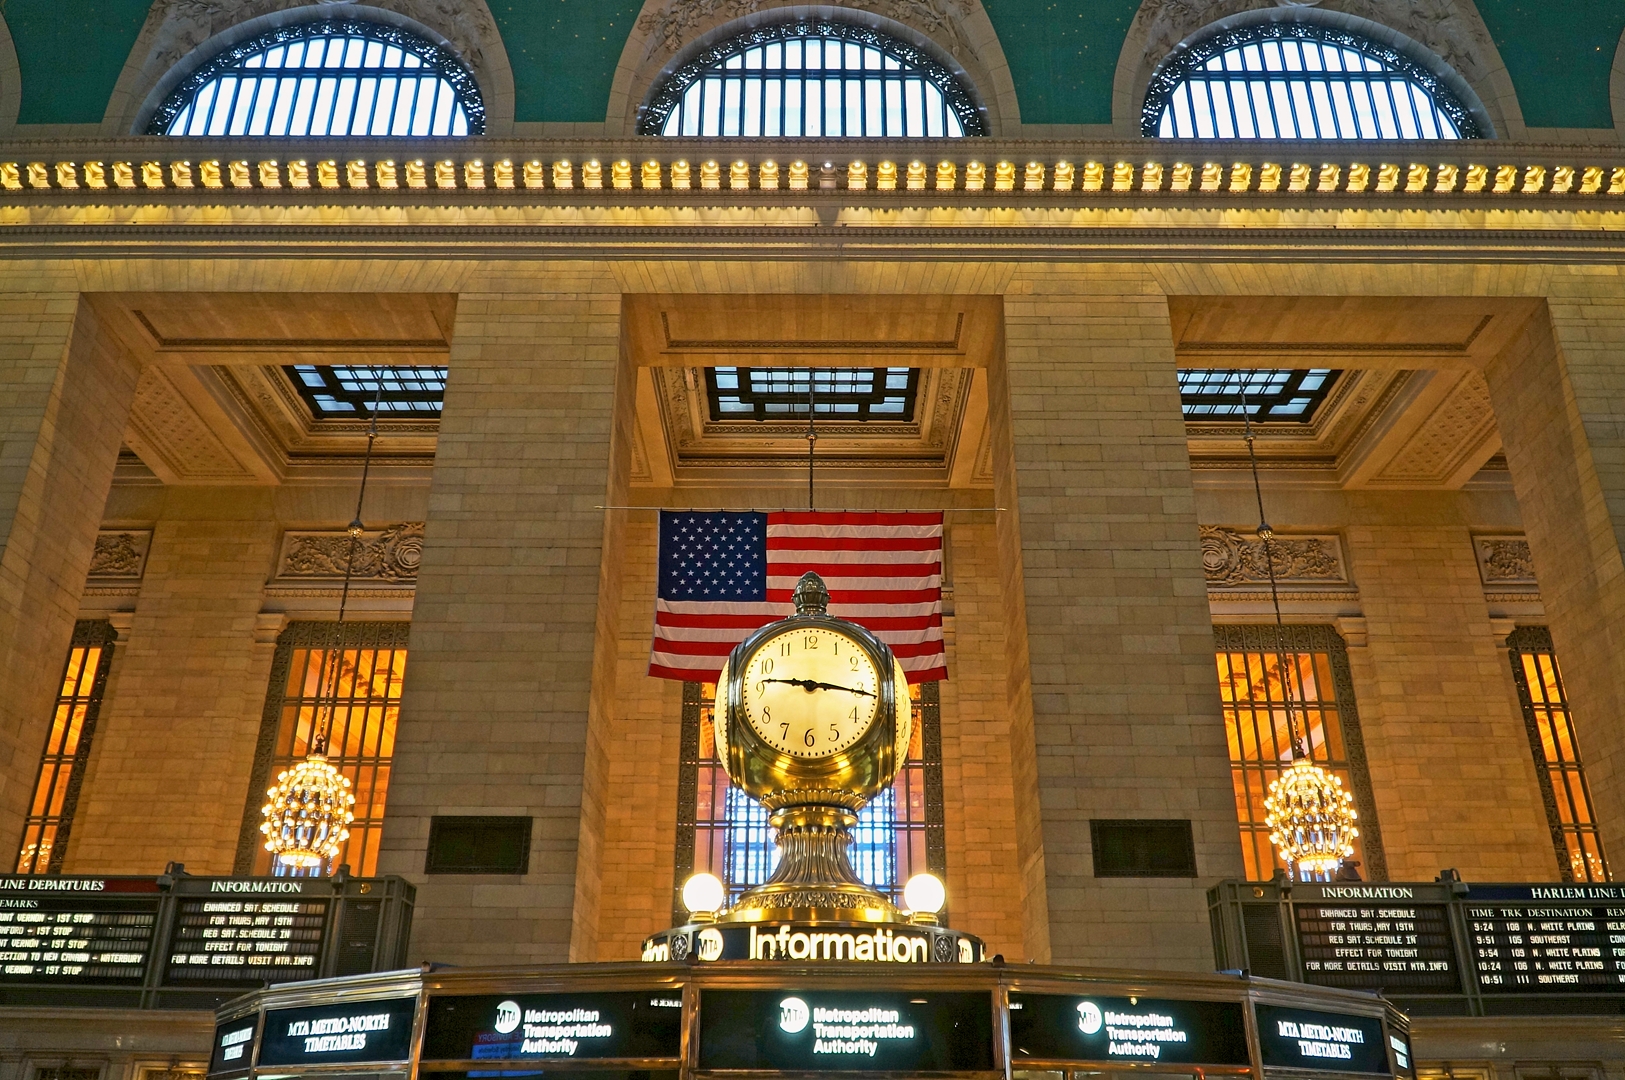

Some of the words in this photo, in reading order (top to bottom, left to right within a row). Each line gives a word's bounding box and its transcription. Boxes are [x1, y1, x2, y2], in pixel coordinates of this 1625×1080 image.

[804, 636, 818, 649] 12
[834, 642, 838, 655] 1
[780, 643, 791, 657] 11
[761, 658, 774, 674] 10
[850, 656, 859, 671] 2
[756, 680, 765, 699] 9
[854, 682, 864, 698] 3
[762, 706, 771, 724] 8
[849, 706, 859, 723] 4
[780, 723, 790, 740] 7
[805, 728, 814, 747] 6
[828, 723, 840, 742] 5
[28, 880, 105, 891] DEPARTURES
[210, 881, 302, 893] INFORMATION
[1321, 888, 1413, 899] INFORMATION
[1531, 888, 1585, 899] HARLEM
[1588, 888, 1618, 898] LINE
[204, 903, 240, 912] ENHANCED
[1320, 909, 1357, 918] ENHANCED
[1469, 909, 1494, 917] TIME
[1501, 909, 1522, 917] TRK
[1527, 908, 1592, 917] DESTINATION
[73, 913, 94, 924] STOP
[210, 916, 225, 925] FOR
[273, 917, 292, 926] 19TH
[53, 927, 73, 936] STOP
[1331, 923, 1346, 931] FOR
[1395, 923, 1414, 932] 19TH
[1474, 923, 1493, 932] 9:24
[1541, 922, 1564, 931] WHITE
[1567, 922, 1595, 931] PLAINS
[203, 929, 218, 938] REG
[279, 930, 290, 939] IN
[1329, 936, 1343, 944] REG
[1406, 935, 1417, 945] IN
[1476, 936, 1495, 944] 9:51
[1530, 936, 1570, 944] SOUTHEAST
[67, 940, 88, 949] STOP
[205, 942, 233, 951] EFFECT
[236, 942, 251, 951] FOR
[255, 943, 288, 952] TONIGHT
[750, 925, 928, 962] Information
[30, 952, 41, 961] TO
[43, 952, 59, 961] NEW
[100, 953, 143, 963] WATERBURY
[171, 955, 186, 964] FOR
[189, 955, 208, 964] MORE
[212, 955, 244, 965] DETAILS
[248, 956, 271, 965] VISIT
[1336, 949, 1363, 957] EFFECT
[1368, 949, 1382, 957] FOR
[1386, 949, 1418, 958] TONIGHT
[1479, 949, 1498, 958] 9:54
[1546, 949, 1569, 957] WHITE
[1572, 949, 1601, 957] PLAINS
[62, 966, 83, 975] STOP
[1306, 962, 1321, 970] FOR
[1324, 962, 1344, 970] MORE
[1347, 962, 1380, 971] DETAILS
[1383, 962, 1407, 971] VISIT
[1478, 962, 1501, 971] 10:24
[1549, 962, 1572, 970] WHITE
[1575, 962, 1604, 970] PLAINS
[1480, 975, 1503, 984] 10:51
[1538, 975, 1579, 984] SOUTHEAST
[525, 1009, 599, 1025] Metropolitan
[813, 1008, 899, 1025] Metropolitan
[1105, 1011, 1173, 1028] Metropolitan
[287, 1022, 309, 1036] MTA
[310, 1014, 390, 1035] METRO-NORTH
[523, 1023, 611, 1040] Transportation
[813, 1023, 914, 1041] Transportation
[1106, 1026, 1187, 1042] Transportation
[1278, 1021, 1300, 1037] MTA
[1299, 1023, 1364, 1043] METRO-NORTH
[305, 1034, 366, 1052] TIMETABLES
[521, 1039, 578, 1055] Authority
[813, 1039, 877, 1056] Authority
[1109, 1041, 1160, 1058] Authority
[1298, 1041, 1351, 1059] TIMETABLES
